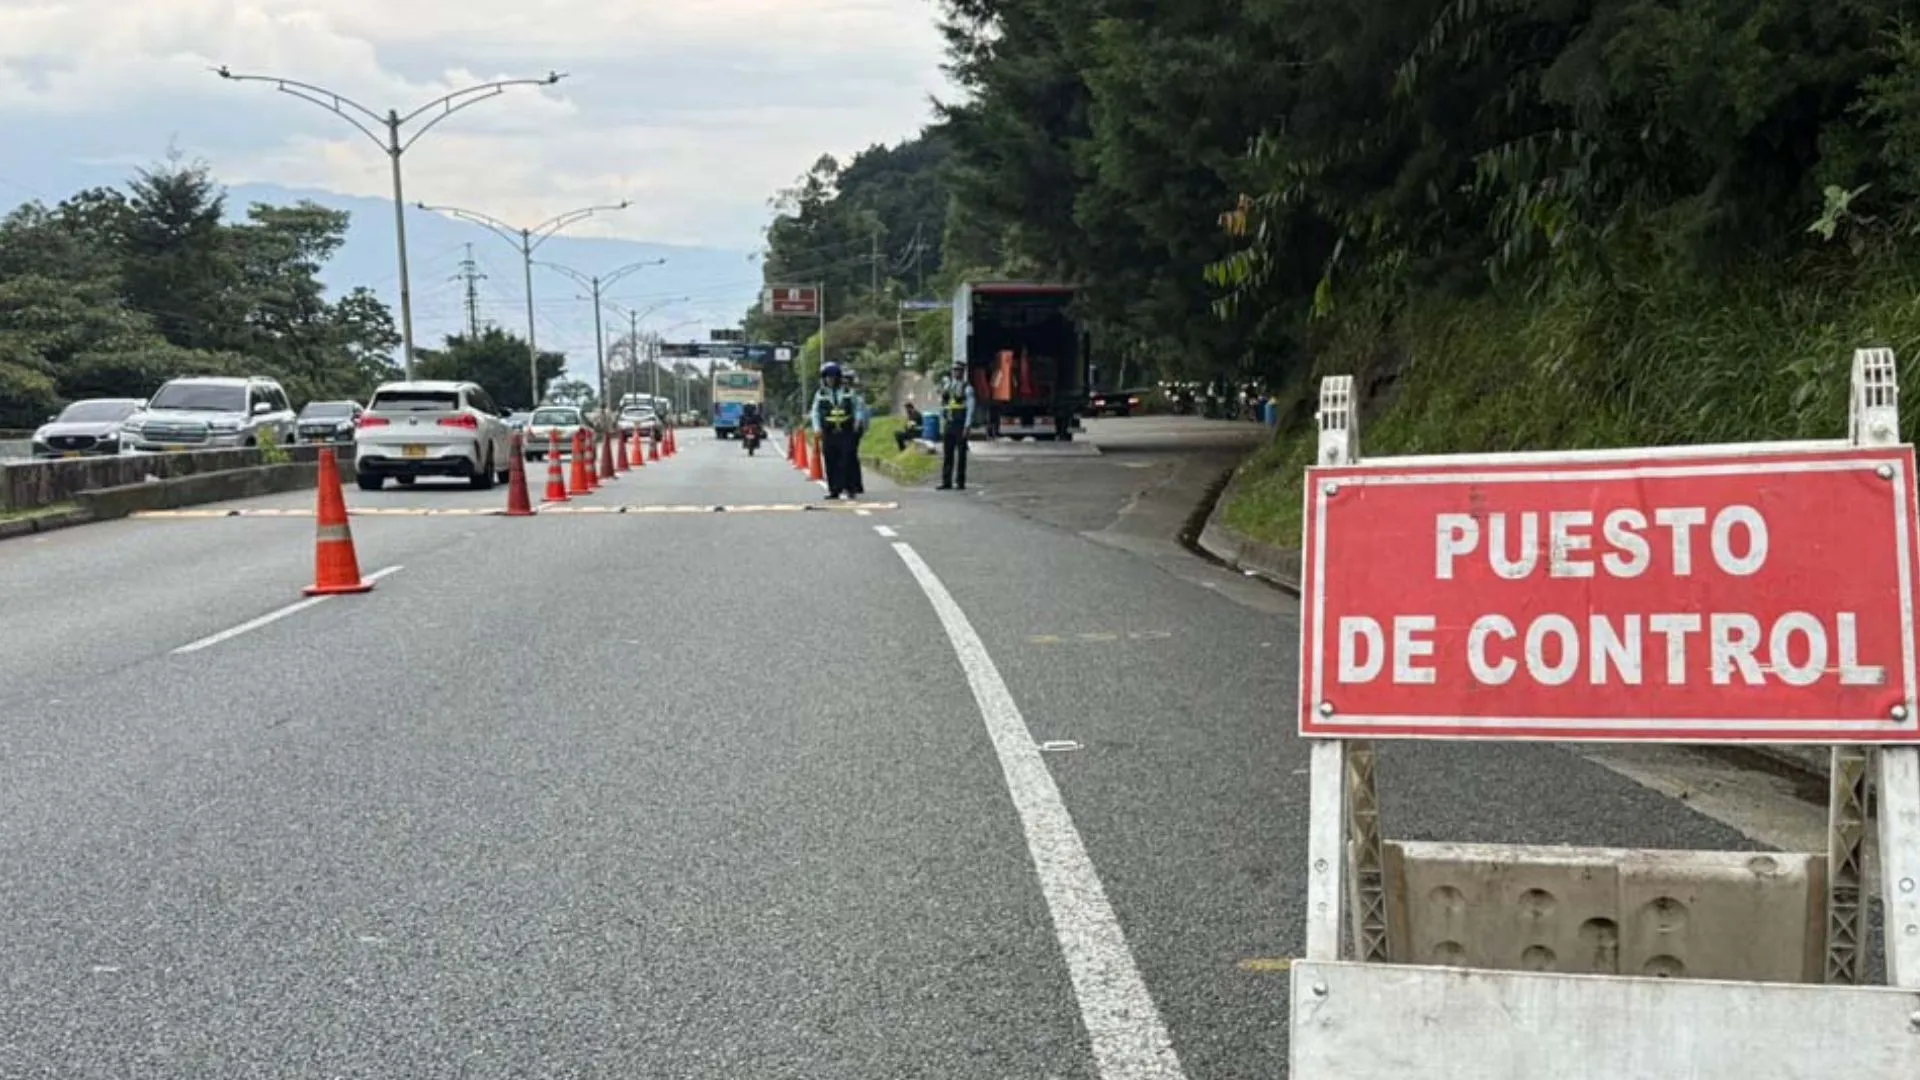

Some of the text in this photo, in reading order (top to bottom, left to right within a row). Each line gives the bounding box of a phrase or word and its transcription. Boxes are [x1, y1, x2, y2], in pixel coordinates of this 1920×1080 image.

[1435, 504, 1769, 580] PUESTO
[1338, 611, 1884, 686] DE CONTROL
